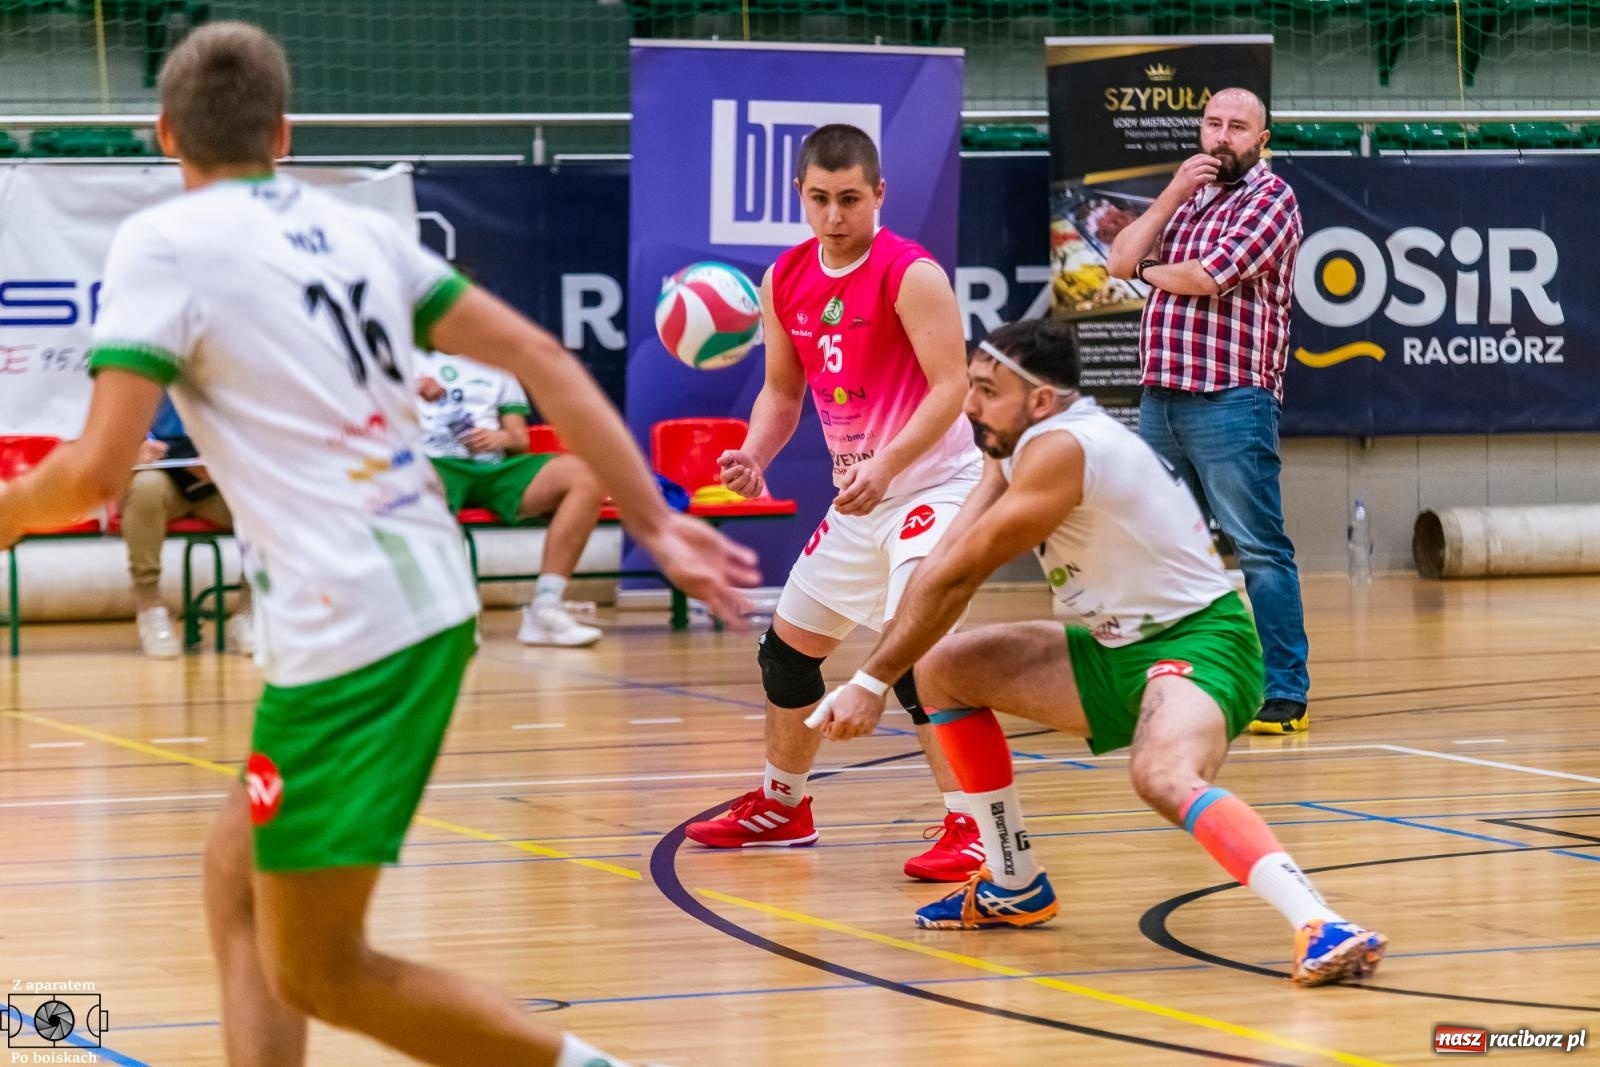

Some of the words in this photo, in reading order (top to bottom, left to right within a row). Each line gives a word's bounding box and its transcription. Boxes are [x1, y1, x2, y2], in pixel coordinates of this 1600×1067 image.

[1294, 226, 1565, 328] OSiR
[304, 277, 404, 388] 16
[817, 334, 843, 374] 15
[1403, 327, 1565, 365] RACIBÓRZ
